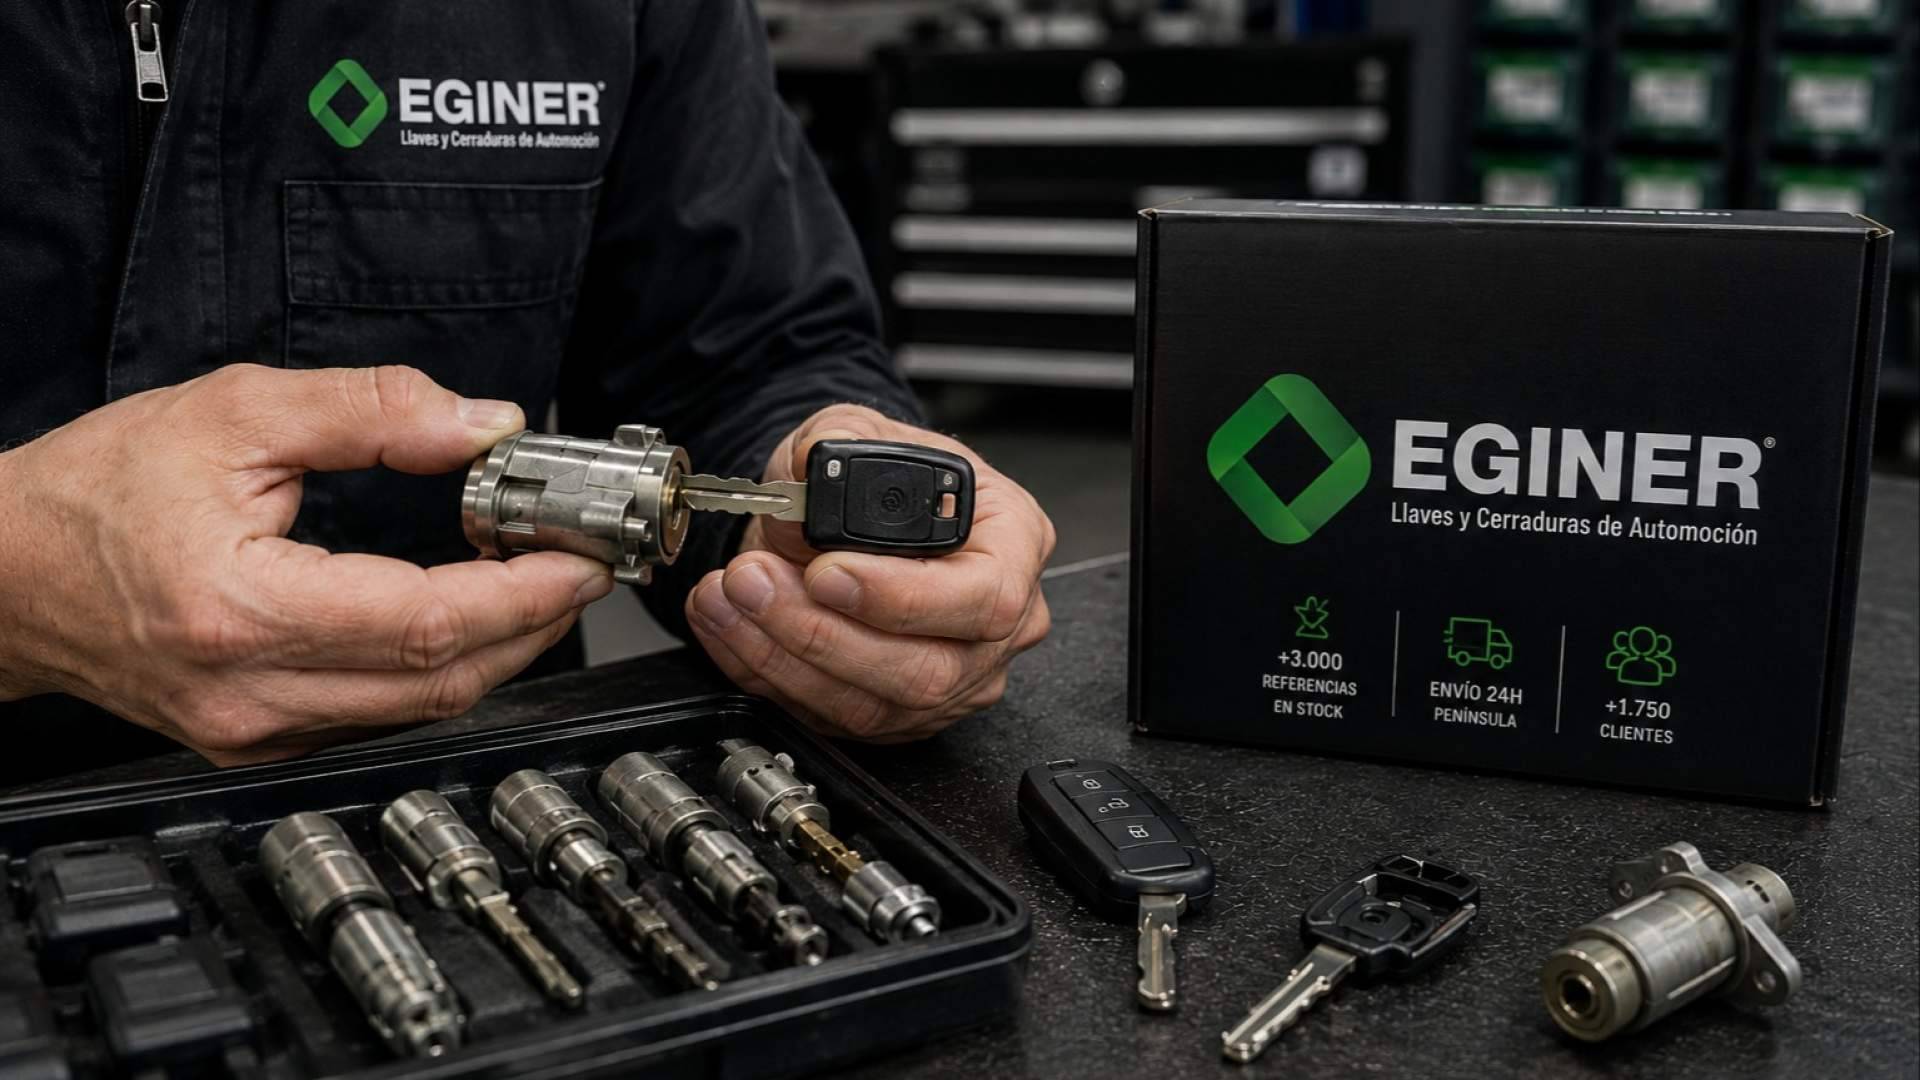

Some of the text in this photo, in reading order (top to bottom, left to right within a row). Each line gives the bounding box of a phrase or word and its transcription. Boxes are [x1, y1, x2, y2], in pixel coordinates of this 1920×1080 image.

[399, 78, 600, 126] EGINER
[401, 129, 439, 146] Llaves
[440, 133, 449, 150] y
[450, 130, 516, 148] Cerraduras
[518, 131, 534, 148] de
[1391, 502, 1759, 546] Llaves y Cerraduras de Automoción
[1278, 649, 1344, 671] +3.000
[1262, 673, 1358, 696] REFERENCIAS
[1429, 680, 1523, 705] ENVÍO 24H
[1273, 699, 1344, 719] EN STOCK
[1433, 704, 1518, 729] PENÍNSULA
[1605, 698, 1671, 720] +1.750
[1599, 723, 1674, 745] CLIENTES
